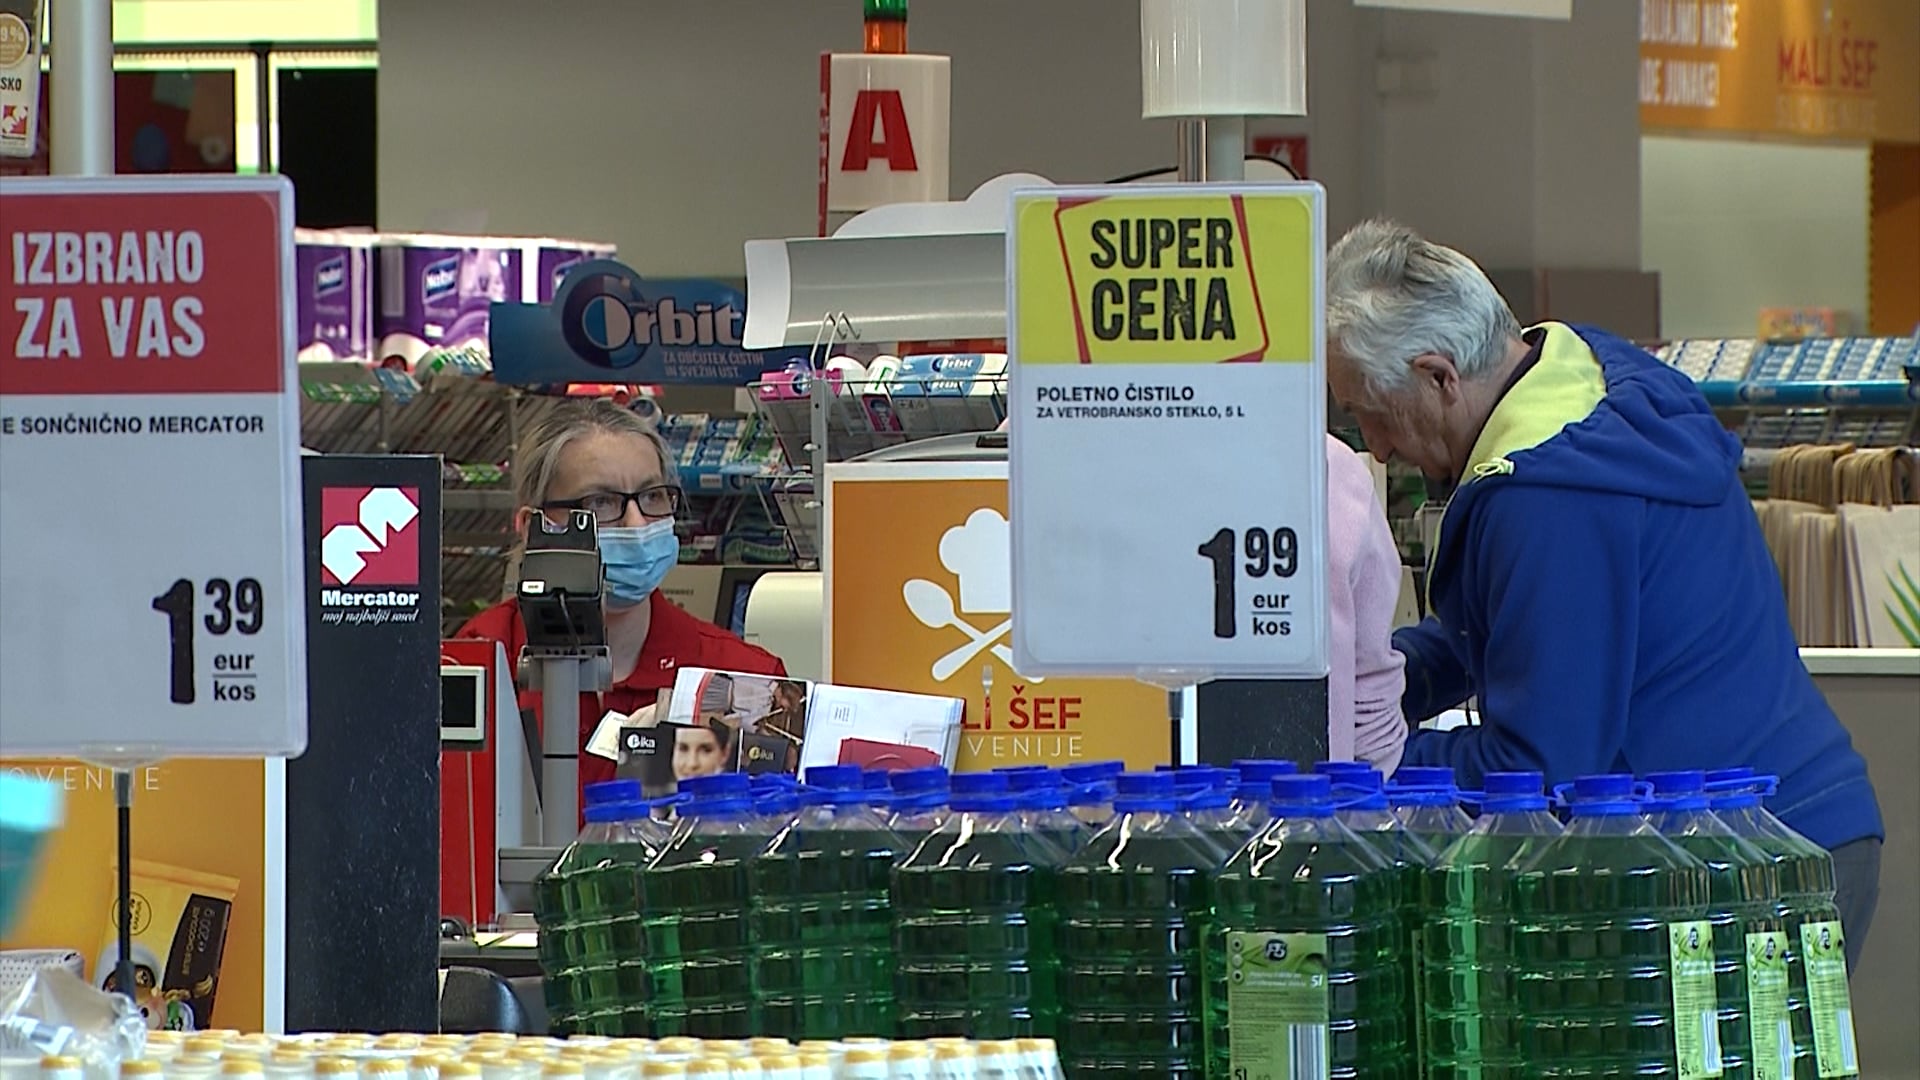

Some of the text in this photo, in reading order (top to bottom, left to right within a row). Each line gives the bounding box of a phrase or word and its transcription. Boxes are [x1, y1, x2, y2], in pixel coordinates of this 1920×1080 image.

[1777, 36, 1831, 86] MALI
[841, 90, 918, 171] A
[12, 231, 204, 285] IZBRANO
[1091, 218, 1234, 268] SUPER
[582, 295, 744, 350] Orbit
[1092, 277, 1237, 341] CENA
[15, 296, 205, 359] ZA VAS
[1037, 383, 1195, 401] POLETNO ČISTILO
[21, 413, 142, 435] SONČNIČNO
[149, 416, 264, 433] MERCATOR
[1037, 407, 1245, 420] ZA VETROBRANSKO STEKLO, 5 L
[321, 590, 419, 606] Mercator
[1198, 527, 1298, 638] 1 99
[322, 609, 345, 626] moj
[1253, 593, 1290, 609] eur
[152, 578, 264, 704] 1 39
[1253, 617, 1291, 635] kos
[214, 655, 254, 671] eur
[214, 681, 256, 701] kos
[1009, 685, 1082, 730] ŠEF
[967, 736, 1083, 757] VENIJE
